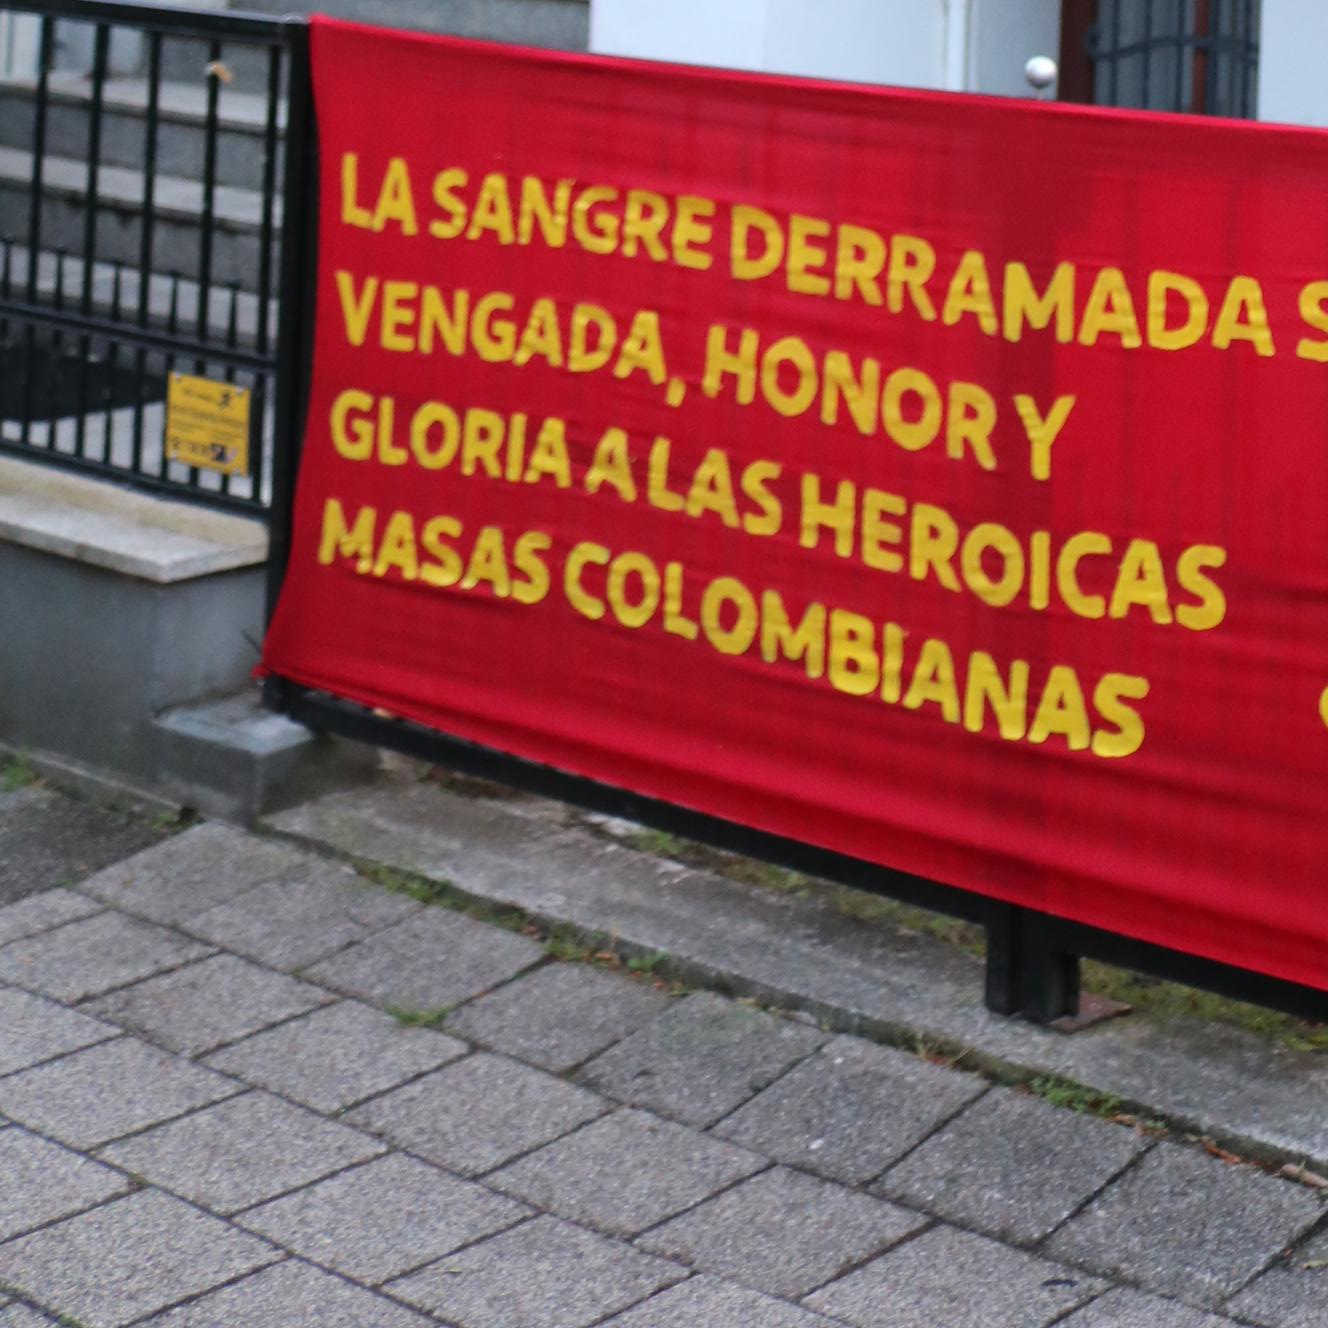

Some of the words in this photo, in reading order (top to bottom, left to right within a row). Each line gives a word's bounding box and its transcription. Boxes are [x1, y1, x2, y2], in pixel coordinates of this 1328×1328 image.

[341, 152, 418, 235] LA
[430, 166, 715, 271] SANGRE
[731, 204, 1275, 358] DERRAMADA
[335, 270, 686, 407] VENGADA,
[703, 324, 998, 471] HONOR
[1013, 394, 1076, 482] Y
[329, 389, 572, 488] GLORIA
[585, 427, 637, 502] A
[647, 437, 783, 536] LAS
[800, 472, 1227, 631] HEROICAS
[318, 498, 551, 605] MASAS
[563, 540, 1150, 759] COLOMBIANAS
